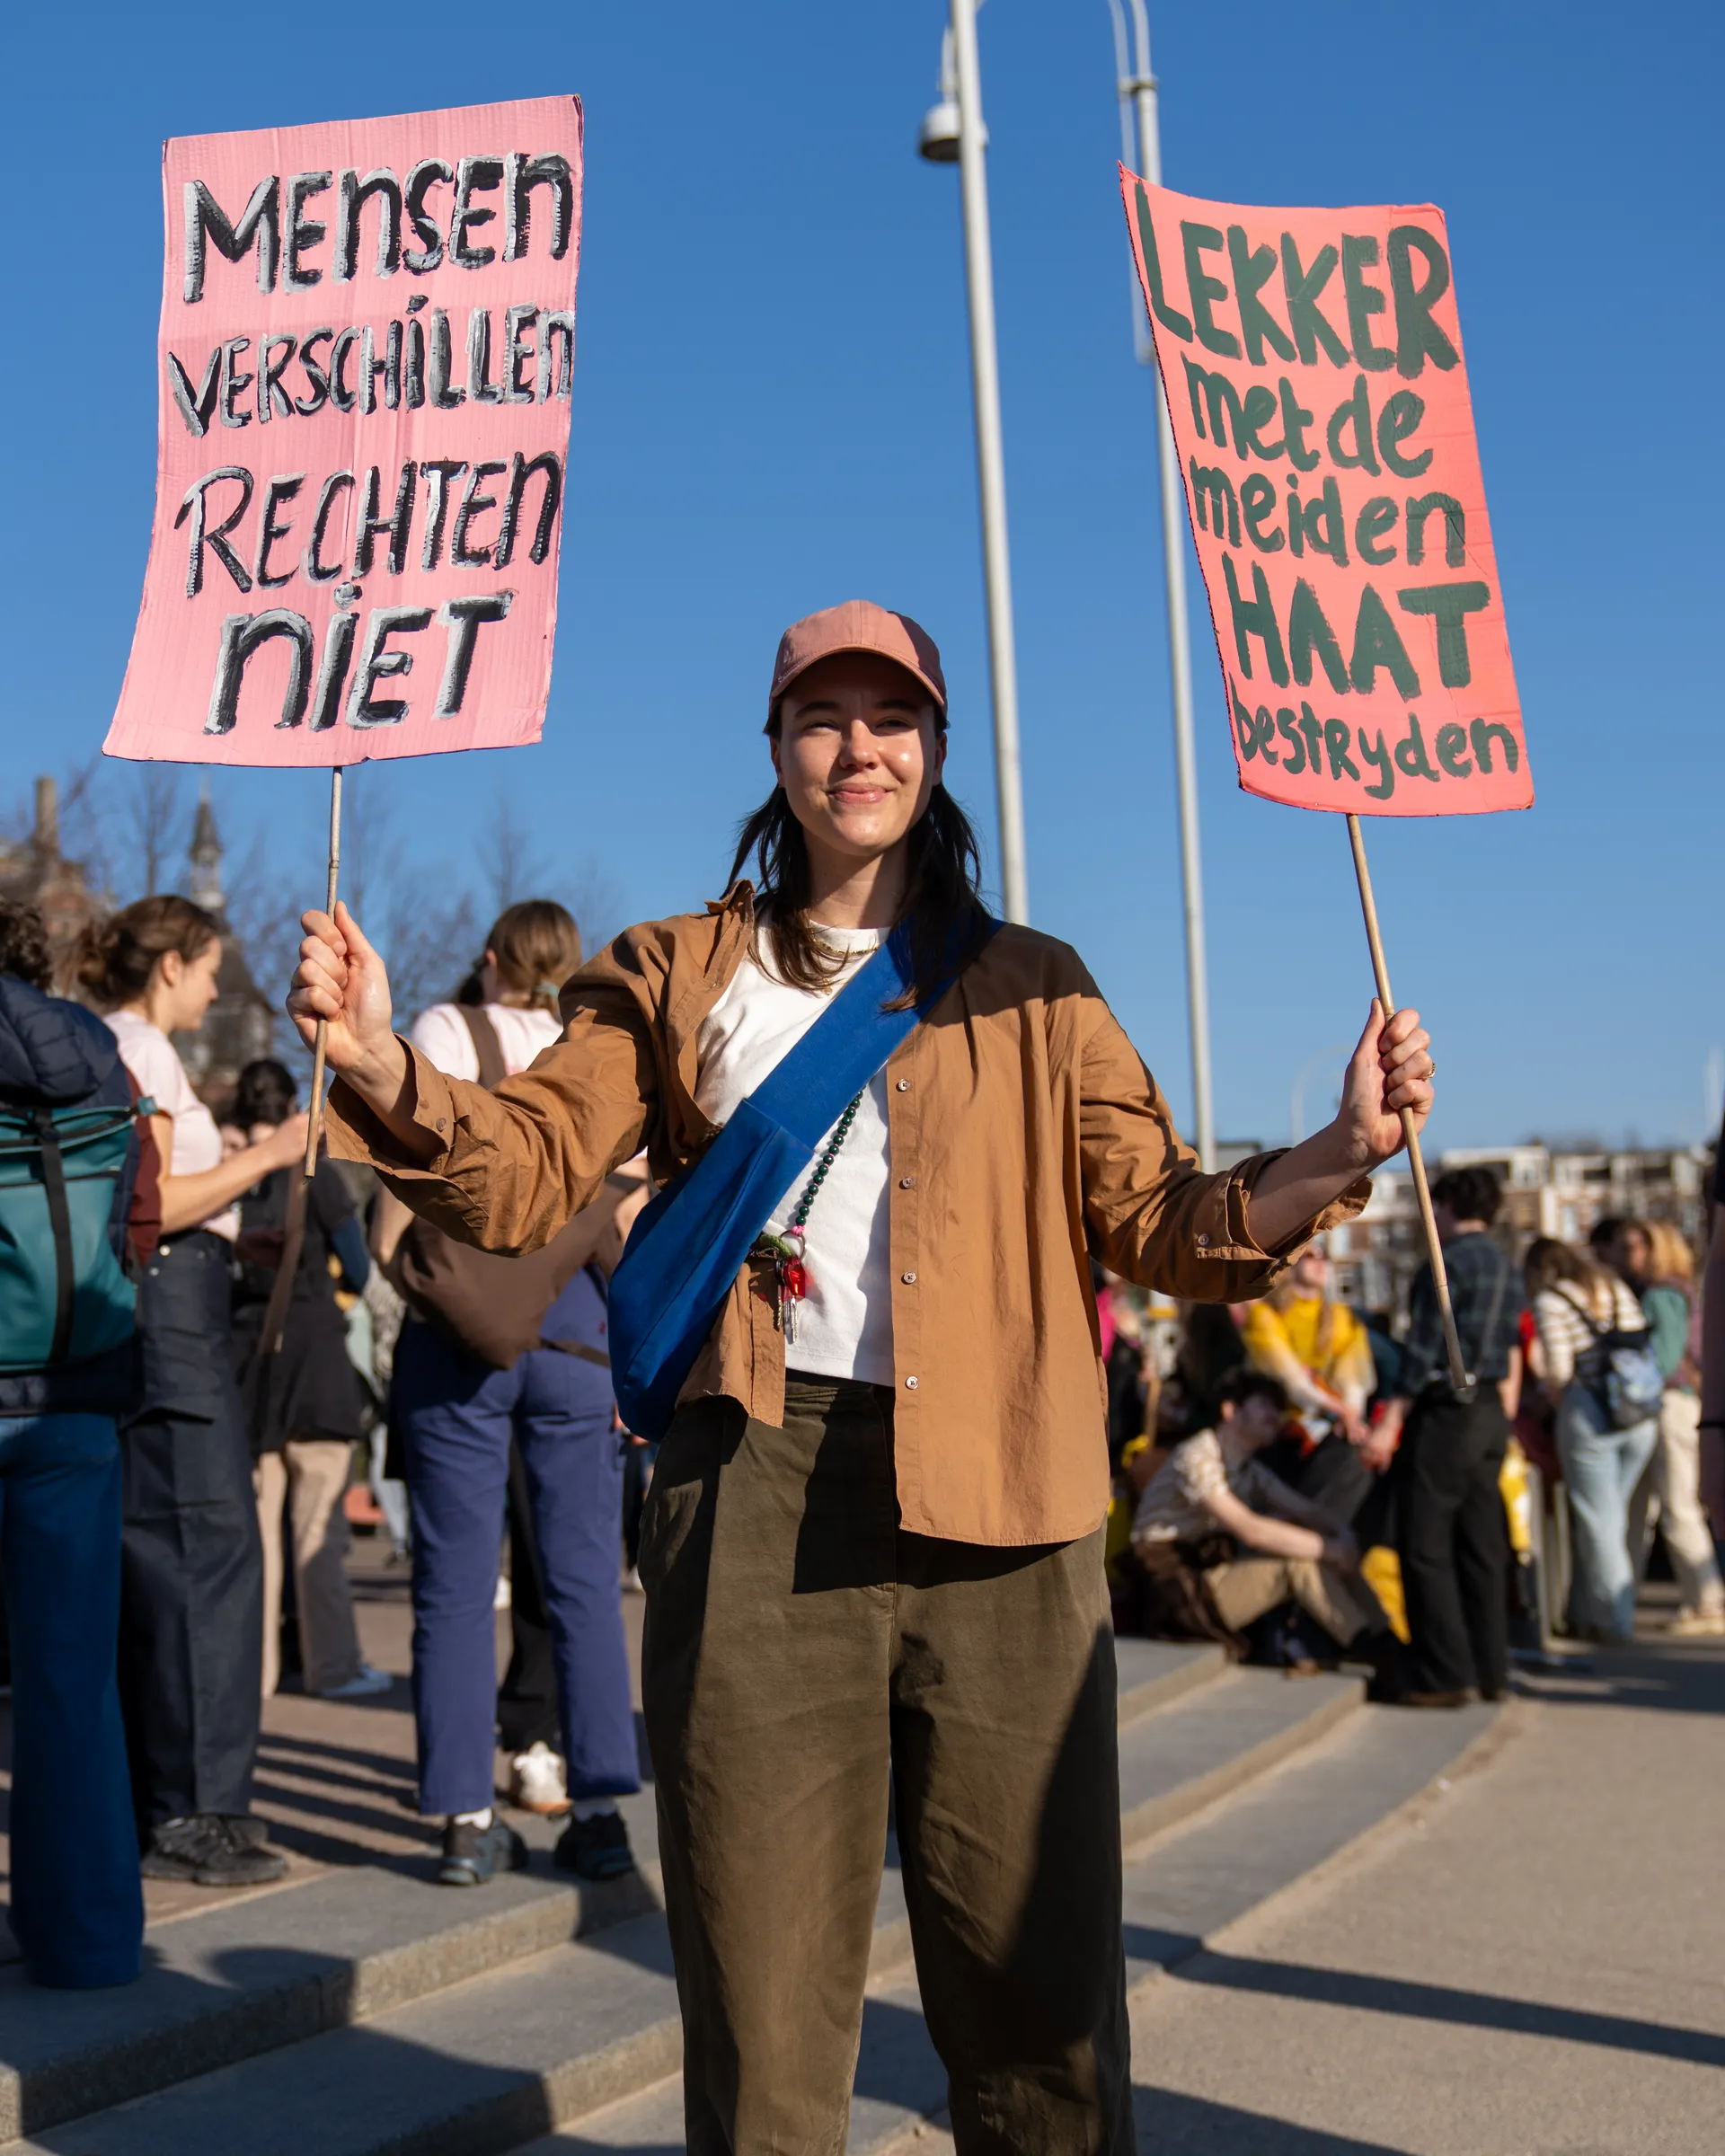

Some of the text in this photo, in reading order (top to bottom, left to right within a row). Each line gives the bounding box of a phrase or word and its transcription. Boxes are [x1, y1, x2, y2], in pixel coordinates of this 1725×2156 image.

[1135, 179, 1462, 380] LEKKER
[1190, 455, 1466, 568] meiden
[1222, 552, 1491, 702] HAAT
